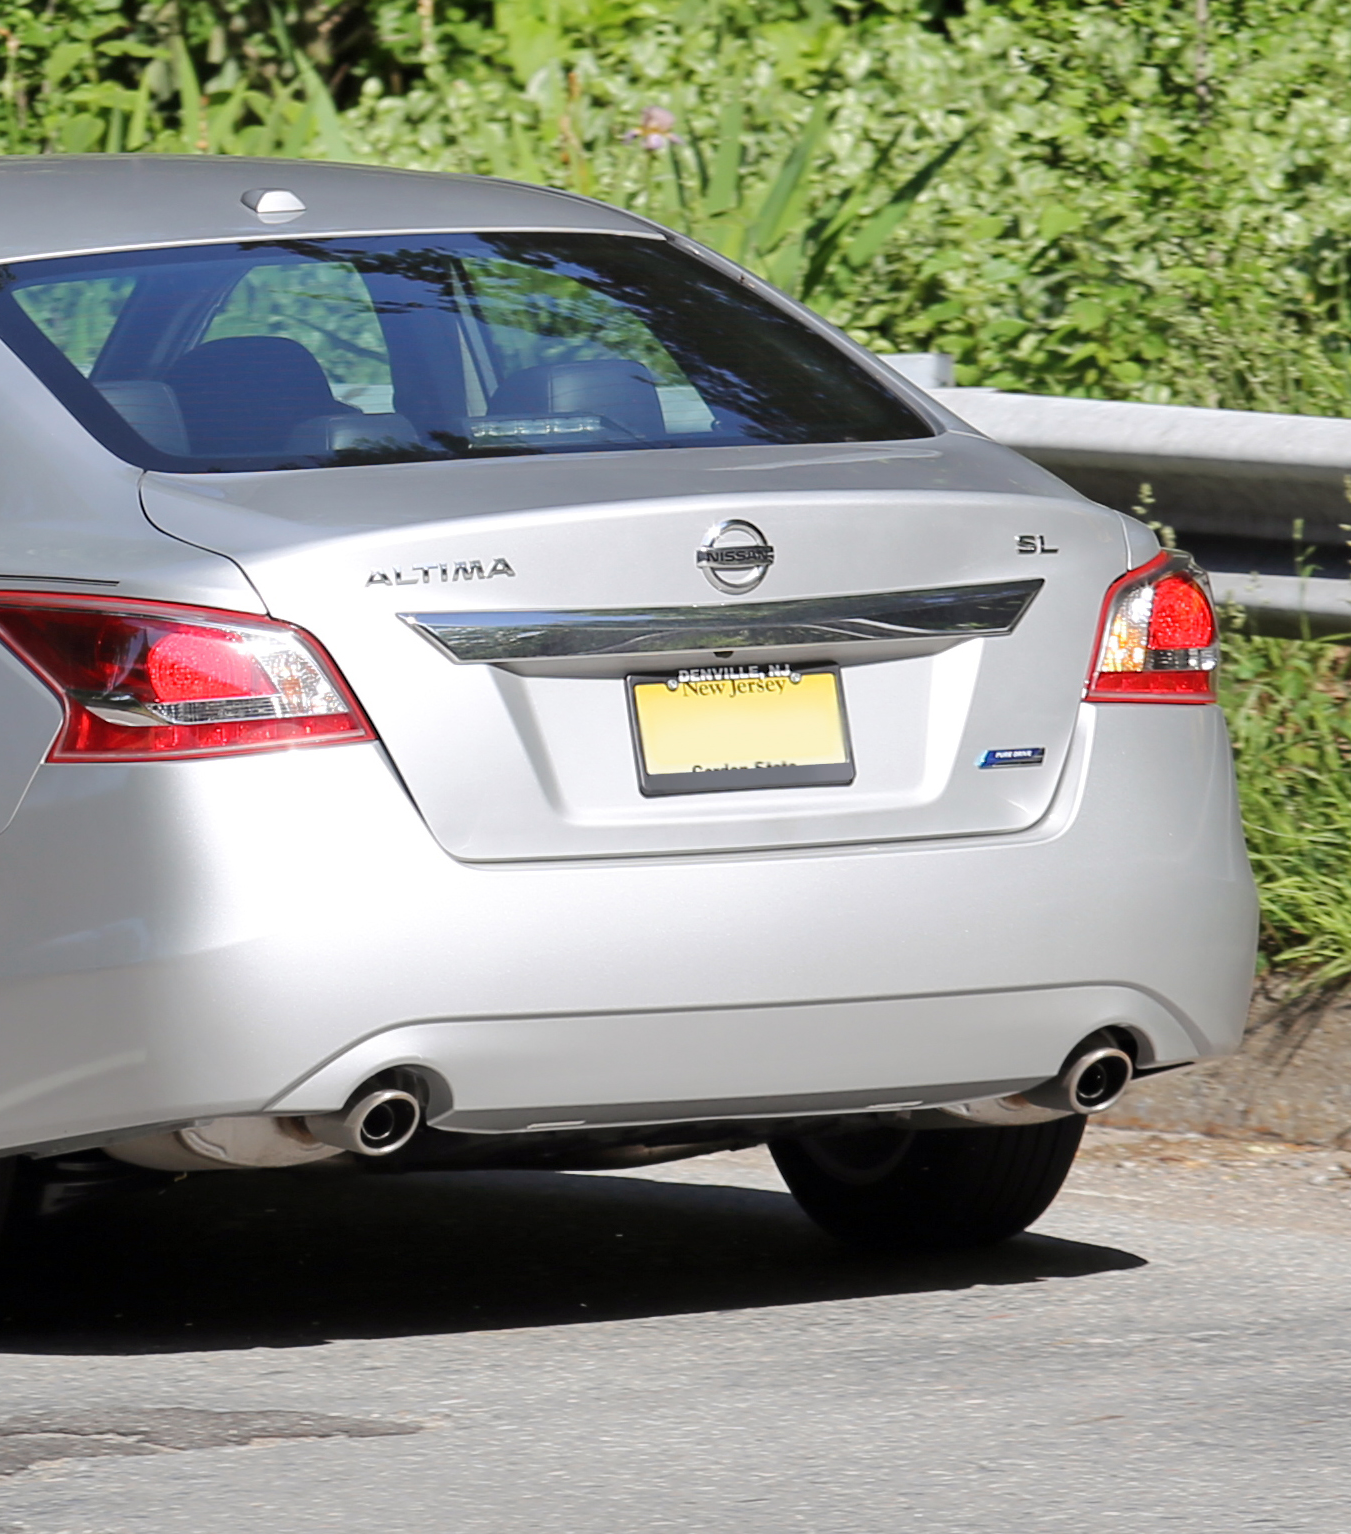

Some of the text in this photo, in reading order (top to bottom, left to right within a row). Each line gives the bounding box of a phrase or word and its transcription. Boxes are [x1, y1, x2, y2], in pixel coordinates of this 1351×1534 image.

[1015, 535, 1059, 555] SL
[707, 549, 768, 563] NISSAN
[365, 557, 516, 588] ALTIMA
[678, 663, 791, 683] DENVILLE, NJ
[682, 677, 787, 699] New Jersey
